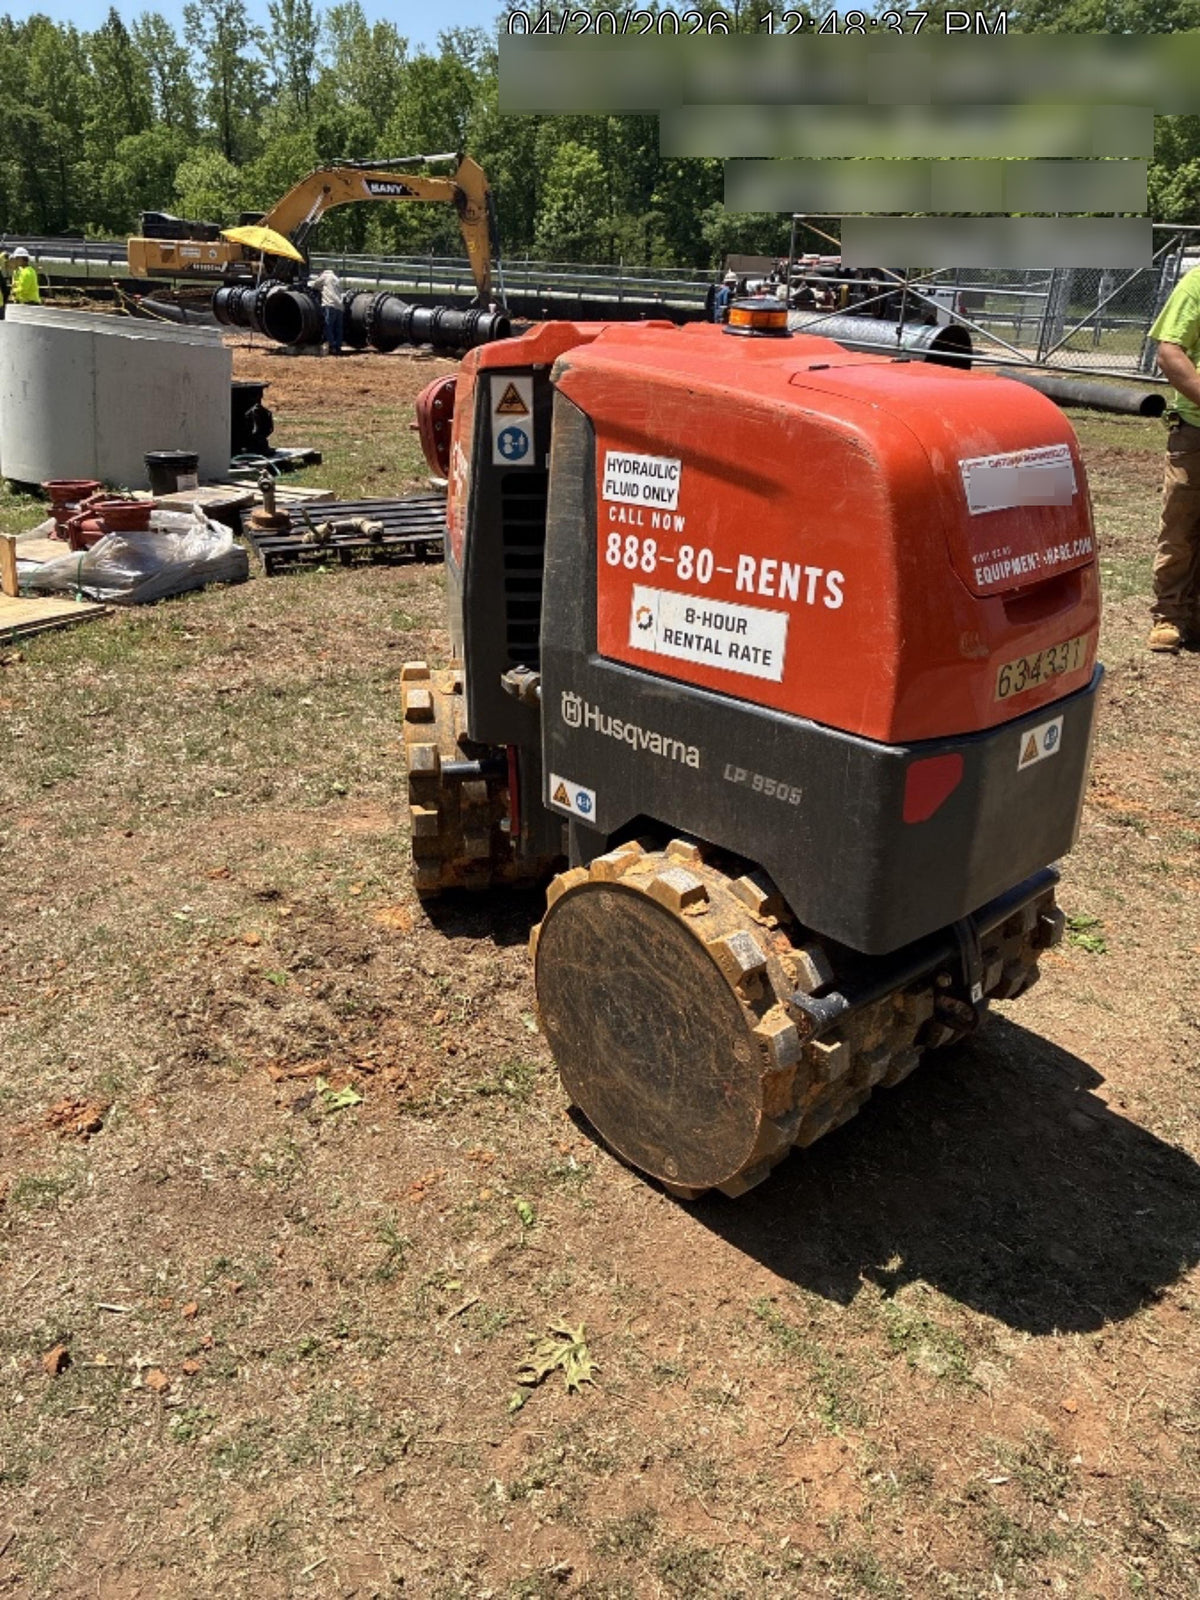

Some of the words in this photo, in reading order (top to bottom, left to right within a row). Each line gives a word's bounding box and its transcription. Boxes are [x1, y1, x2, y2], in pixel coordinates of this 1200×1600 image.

[607, 458, 679, 480] HYDRAULIC
[605, 480, 639, 497] FLUID
[643, 485, 676, 503] ONLY
[609, 506, 644, 526] CALL
[652, 512, 686, 533] NOW
[605, 532, 846, 609] 888-80-RENTS
[685, 608, 748, 635] 8-HOUR
[663, 628, 723, 656] RENTAL
[728, 642, 773, 666] RATE
[583, 702, 700, 769] Husqvarna
[723, 764, 747, 783] LP
[751, 771, 803, 806] 9505
